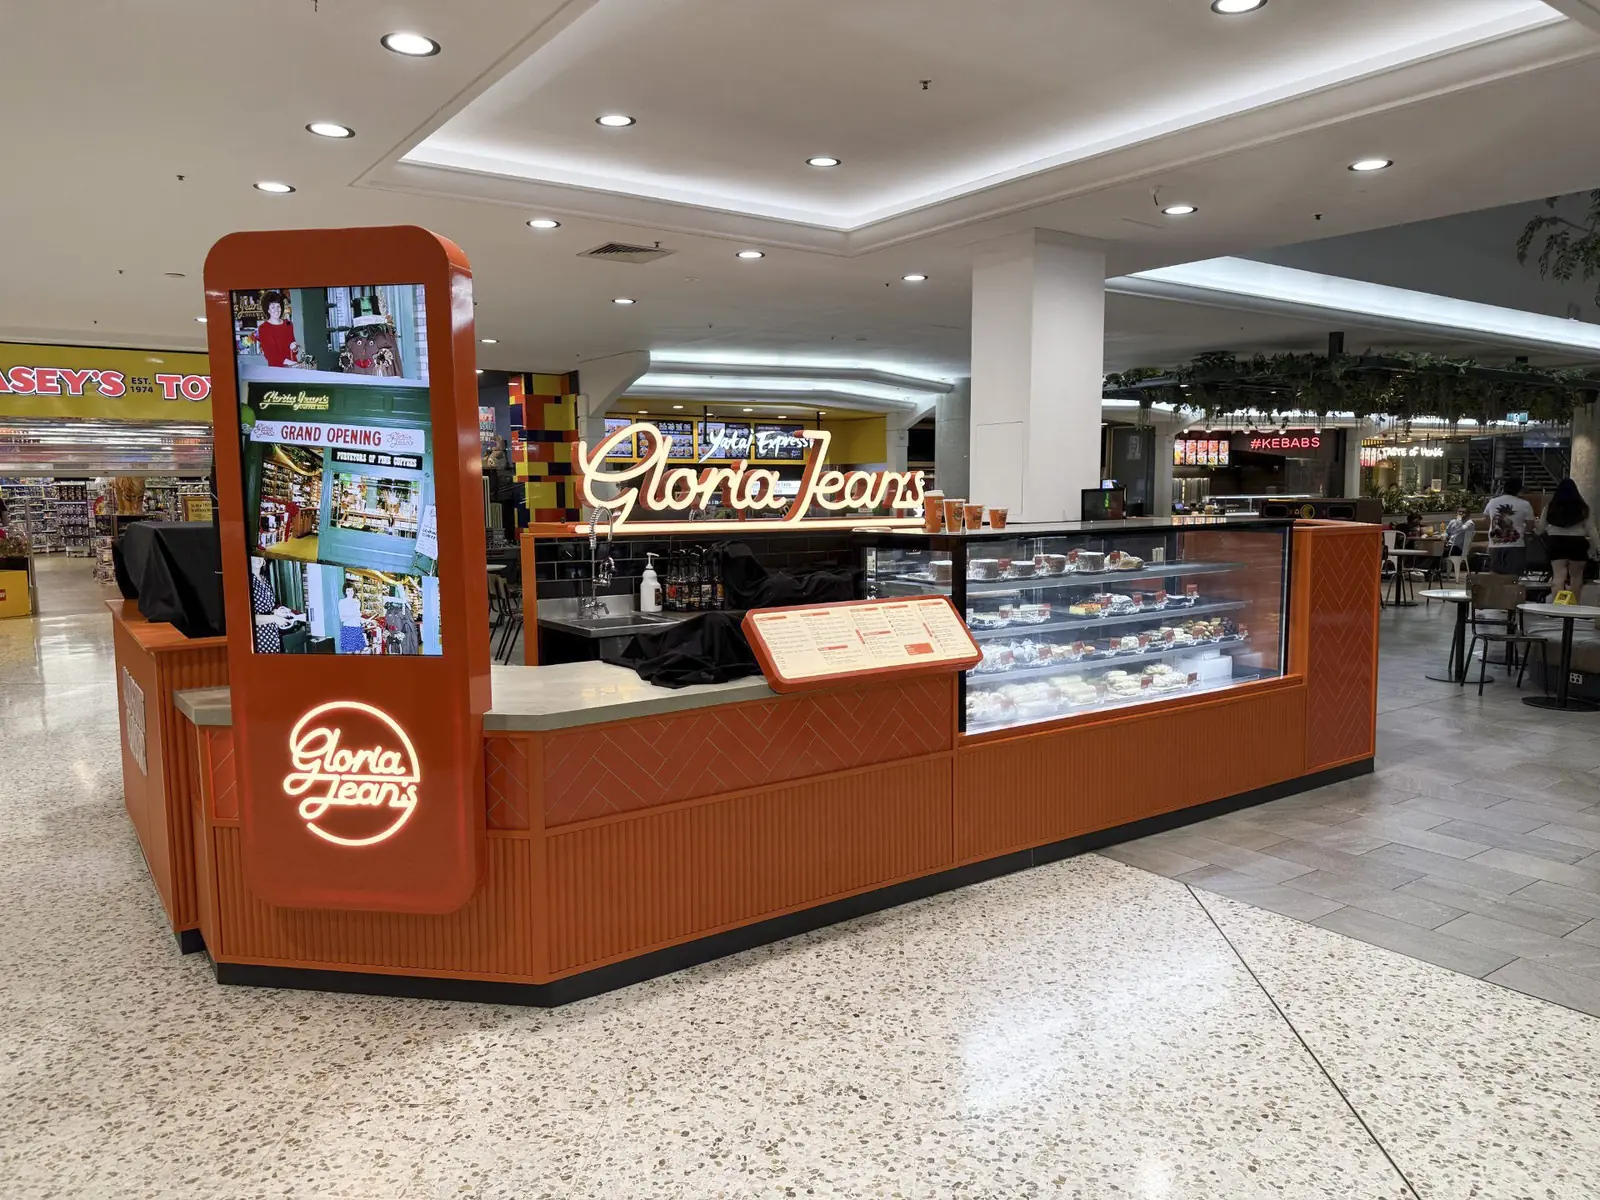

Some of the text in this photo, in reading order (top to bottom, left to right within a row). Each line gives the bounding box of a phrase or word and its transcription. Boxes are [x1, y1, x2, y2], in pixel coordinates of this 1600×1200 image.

[131, 377, 151, 385] EST.
[155, 374, 211, 400] TO
[281, 425, 382, 446] GRAND OPENING
[1250, 437, 1320, 450] #KEBABS
[577, 422, 786, 524] Gloria
[283, 727, 406, 795] Gloria
